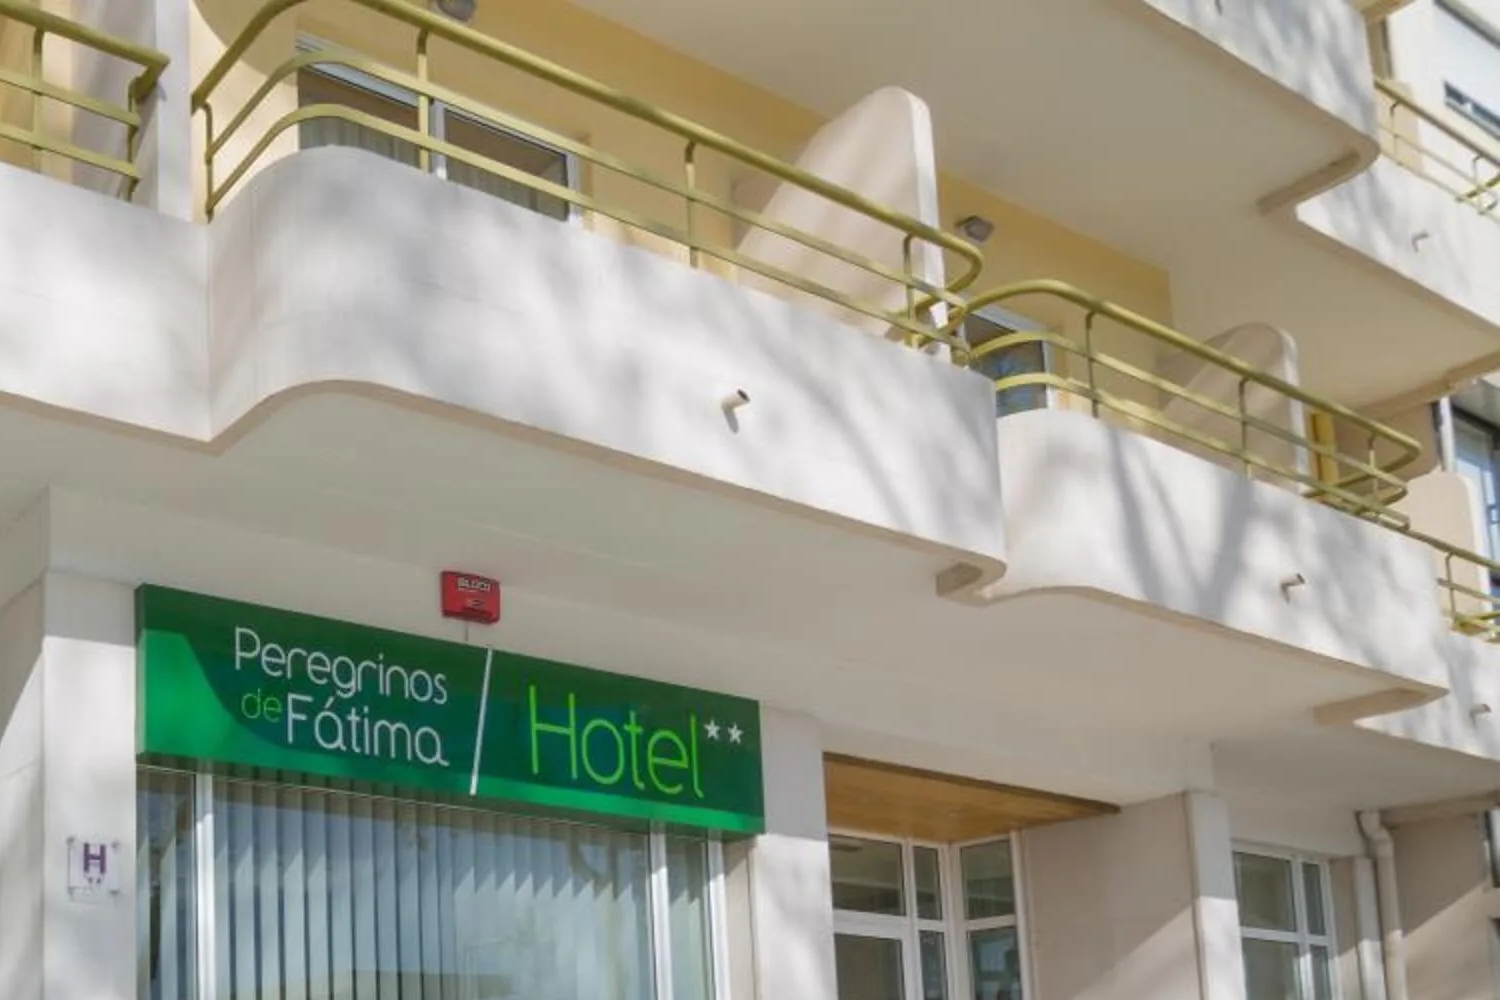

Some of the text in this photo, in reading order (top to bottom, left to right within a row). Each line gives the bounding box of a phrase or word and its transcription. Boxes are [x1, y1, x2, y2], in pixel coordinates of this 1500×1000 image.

[234, 626, 449, 705] Peregrinos
[240, 687, 450, 768] de Fátima
[528, 684, 704, 799] Hotel
[83, 842, 107, 875] H
